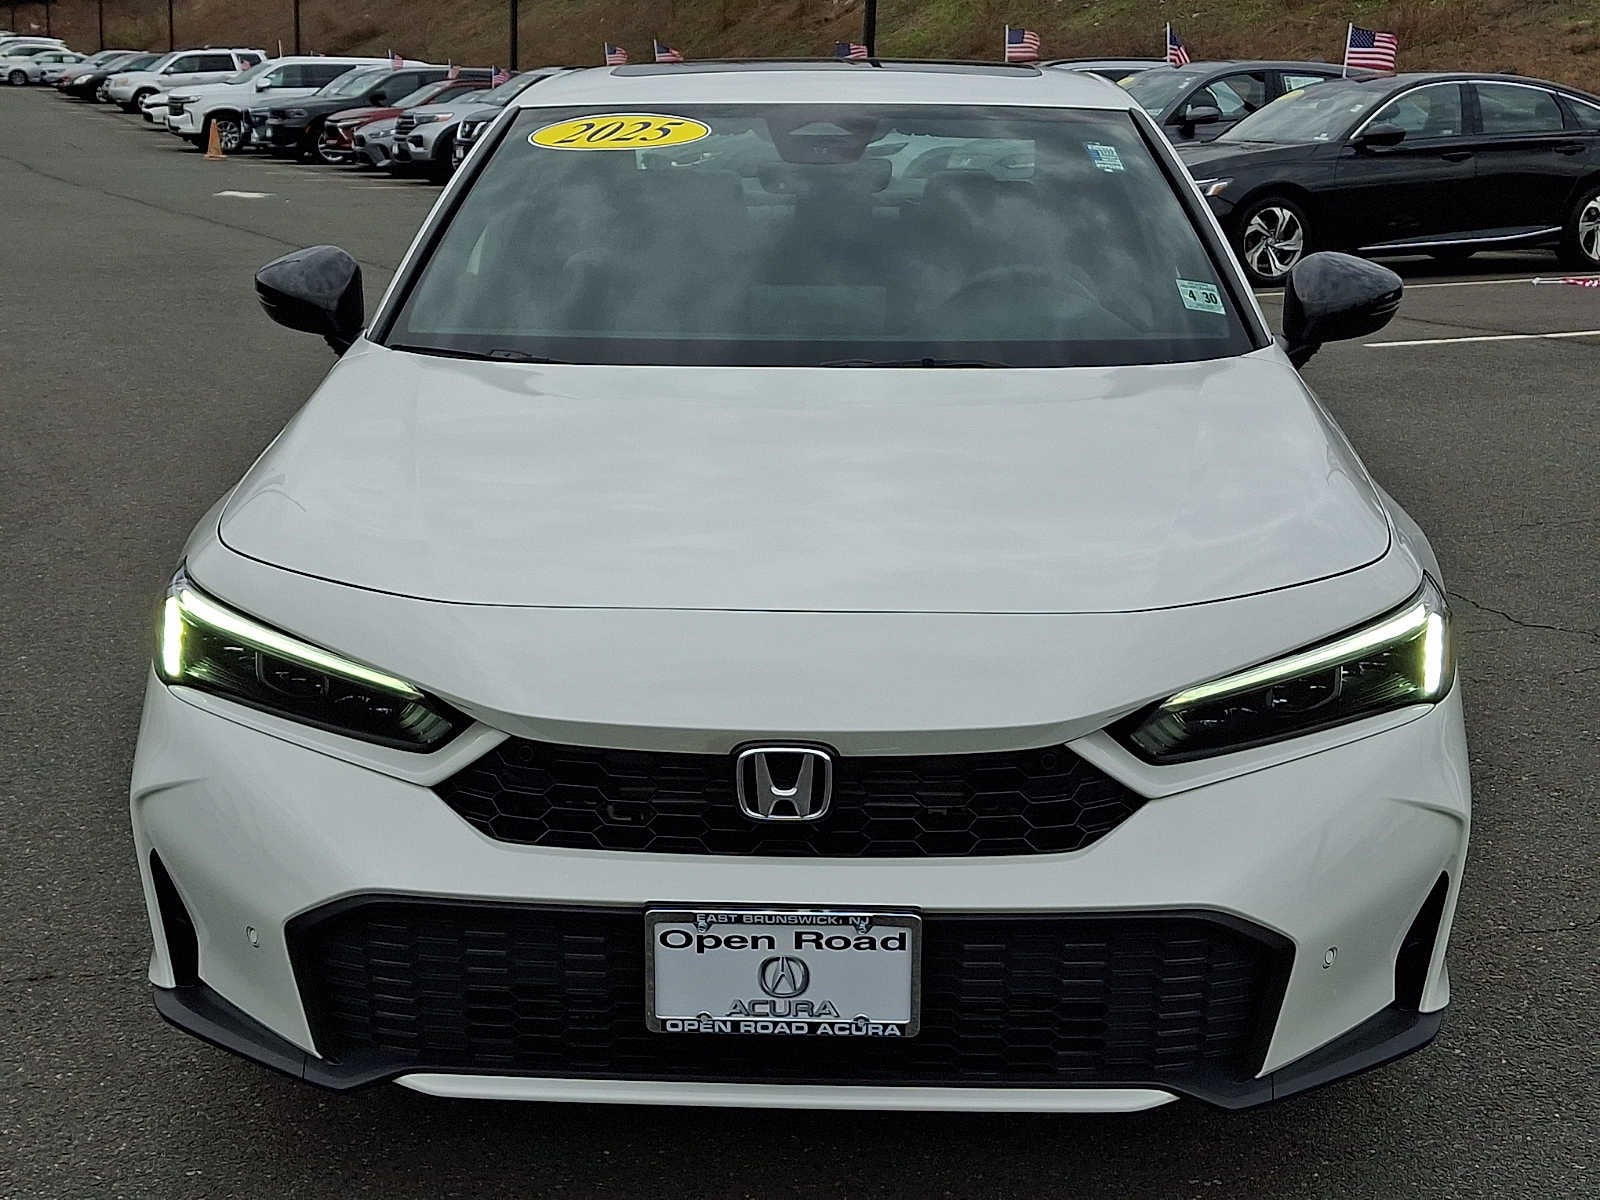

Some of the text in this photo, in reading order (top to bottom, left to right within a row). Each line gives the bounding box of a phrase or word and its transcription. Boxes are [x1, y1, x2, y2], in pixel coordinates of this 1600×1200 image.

[554, 121, 685, 144] 2025
[1188, 289, 1218, 305] 4 30
[696, 913, 738, 924] EAST
[848, 916, 870, 925] NJ
[658, 930, 907, 953] Open Road
[725, 999, 840, 1018] ACURA
[665, 1019, 901, 1036] OPEN ROAD ACURA
